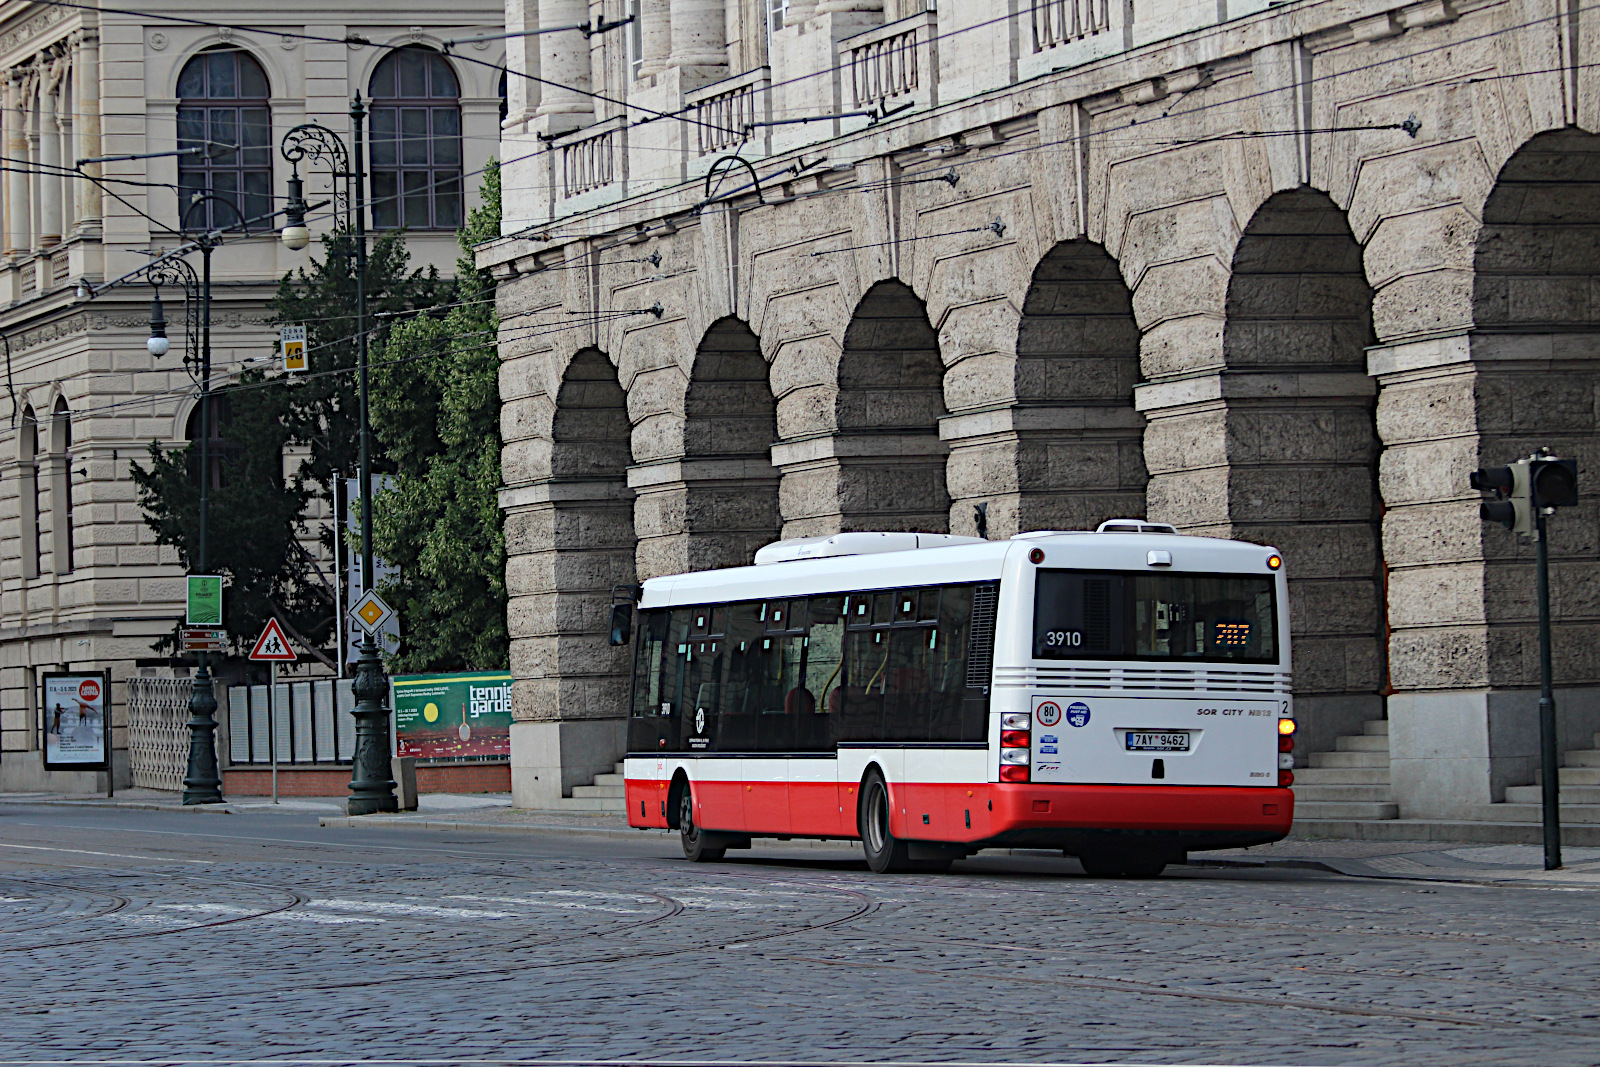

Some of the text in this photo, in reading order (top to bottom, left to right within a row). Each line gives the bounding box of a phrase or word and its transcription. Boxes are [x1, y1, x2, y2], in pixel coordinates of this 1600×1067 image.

[287, 347, 303, 361] 40
[1046, 631, 1081, 647] 3910
[469, 681, 512, 701] tennis
[470, 699, 512, 718] garde
[1044, 706, 1054, 717] 80
[1196, 708, 1272, 717] SOR CITY NB12
[1282, 700, 1289, 714] 2
[1135, 734, 1153, 745] 7AY
[1160, 735, 1185, 746] 9462
